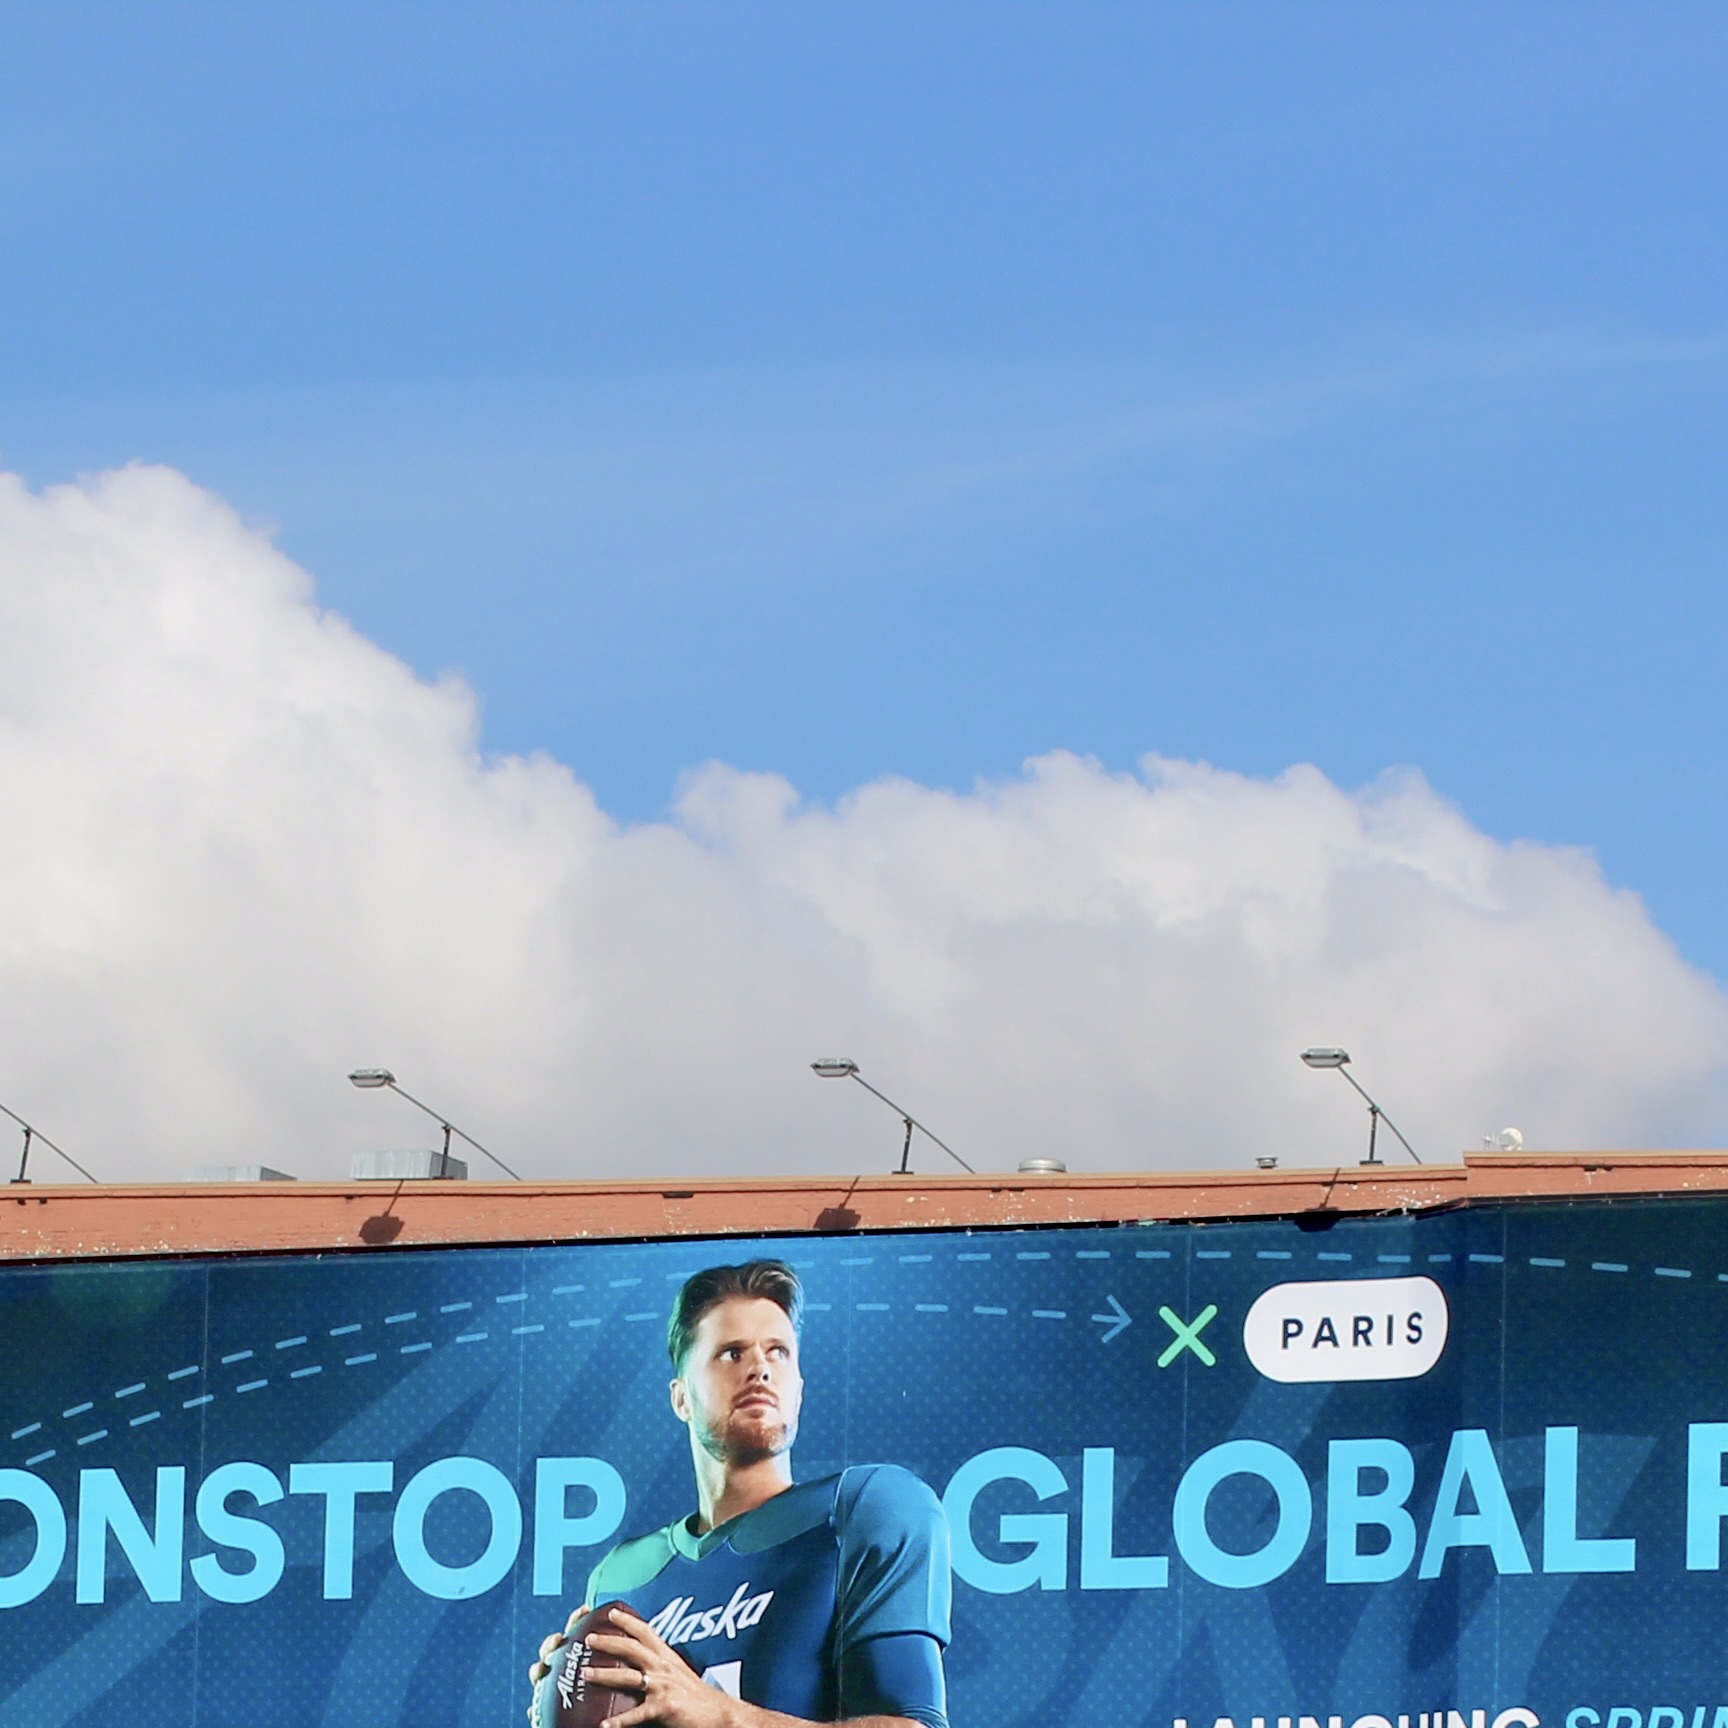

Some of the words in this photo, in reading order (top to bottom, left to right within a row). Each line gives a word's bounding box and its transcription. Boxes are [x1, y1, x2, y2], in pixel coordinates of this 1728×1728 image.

[1281, 1312, 1426, 1350] PARIS
[941, 1426, 1636, 1594] GLOBAL
[556, 1641, 583, 1710] Alaska
